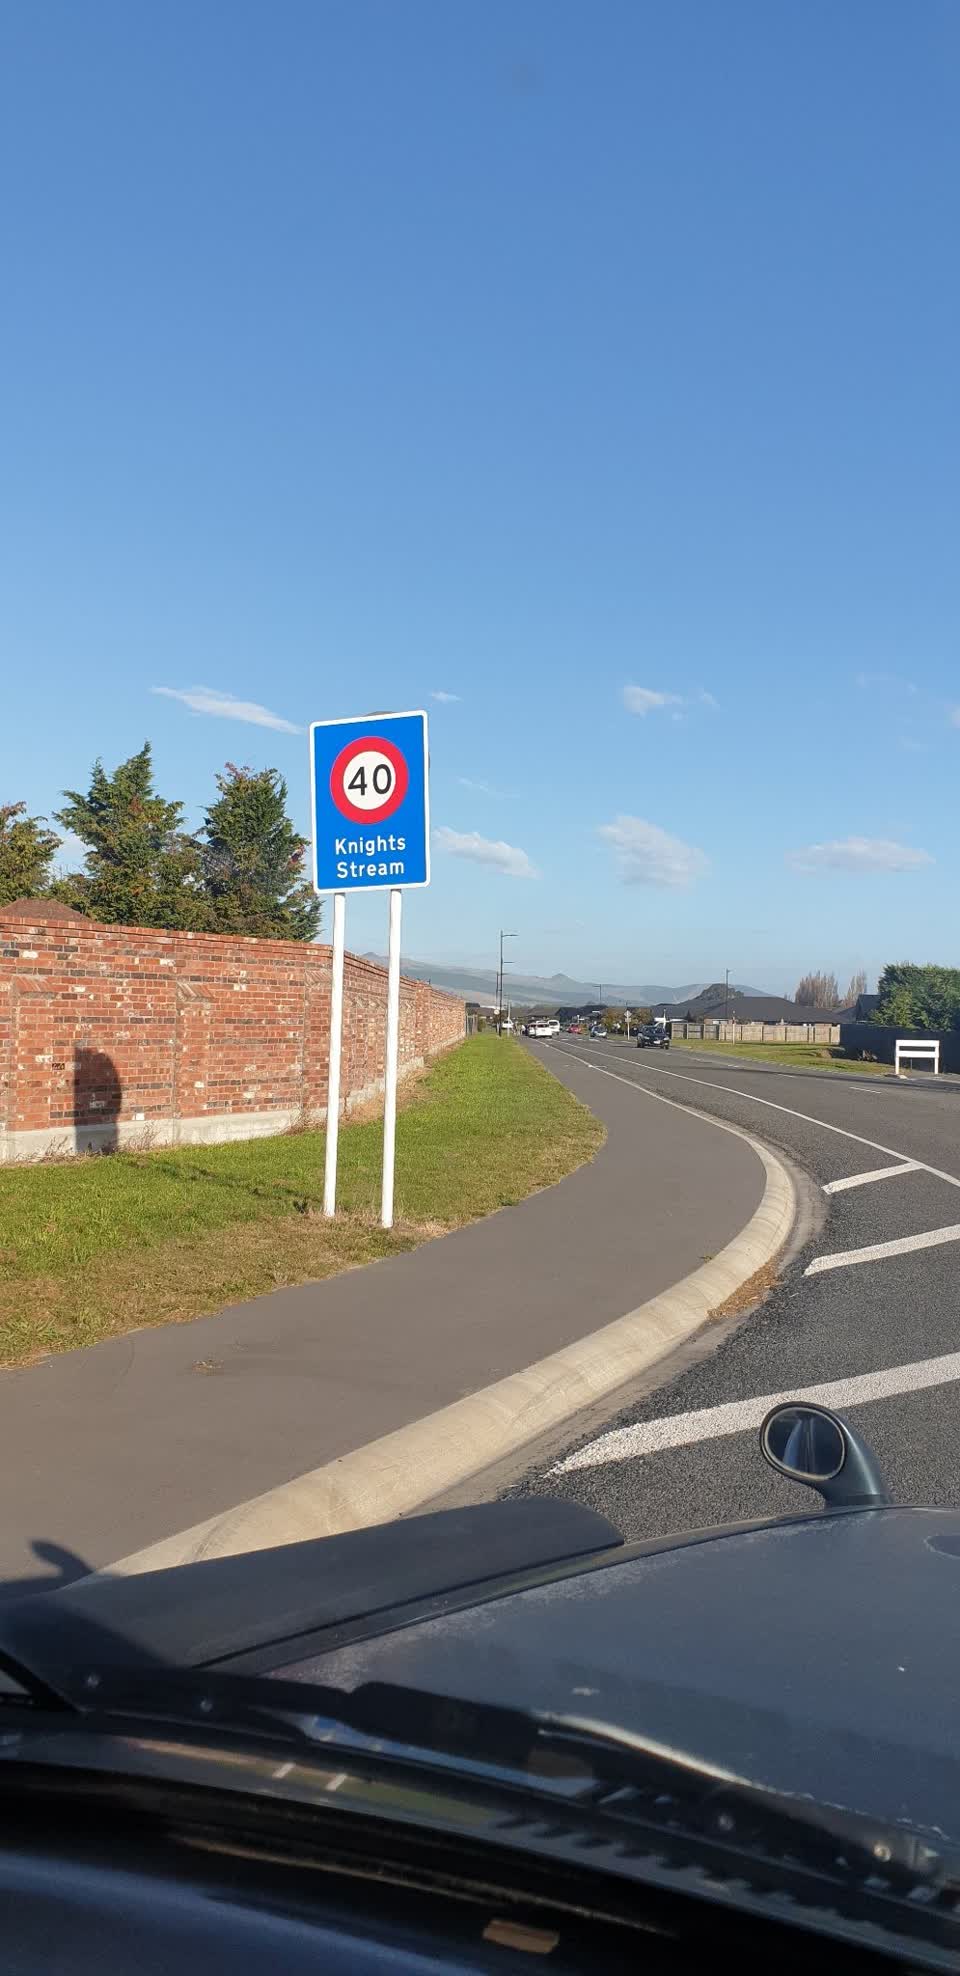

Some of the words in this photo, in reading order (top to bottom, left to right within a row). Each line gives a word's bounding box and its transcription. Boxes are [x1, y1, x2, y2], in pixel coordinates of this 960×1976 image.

[348, 764, 392, 796] 40
[335, 834, 406, 857] Knights
[336, 861, 405, 879] Stream
